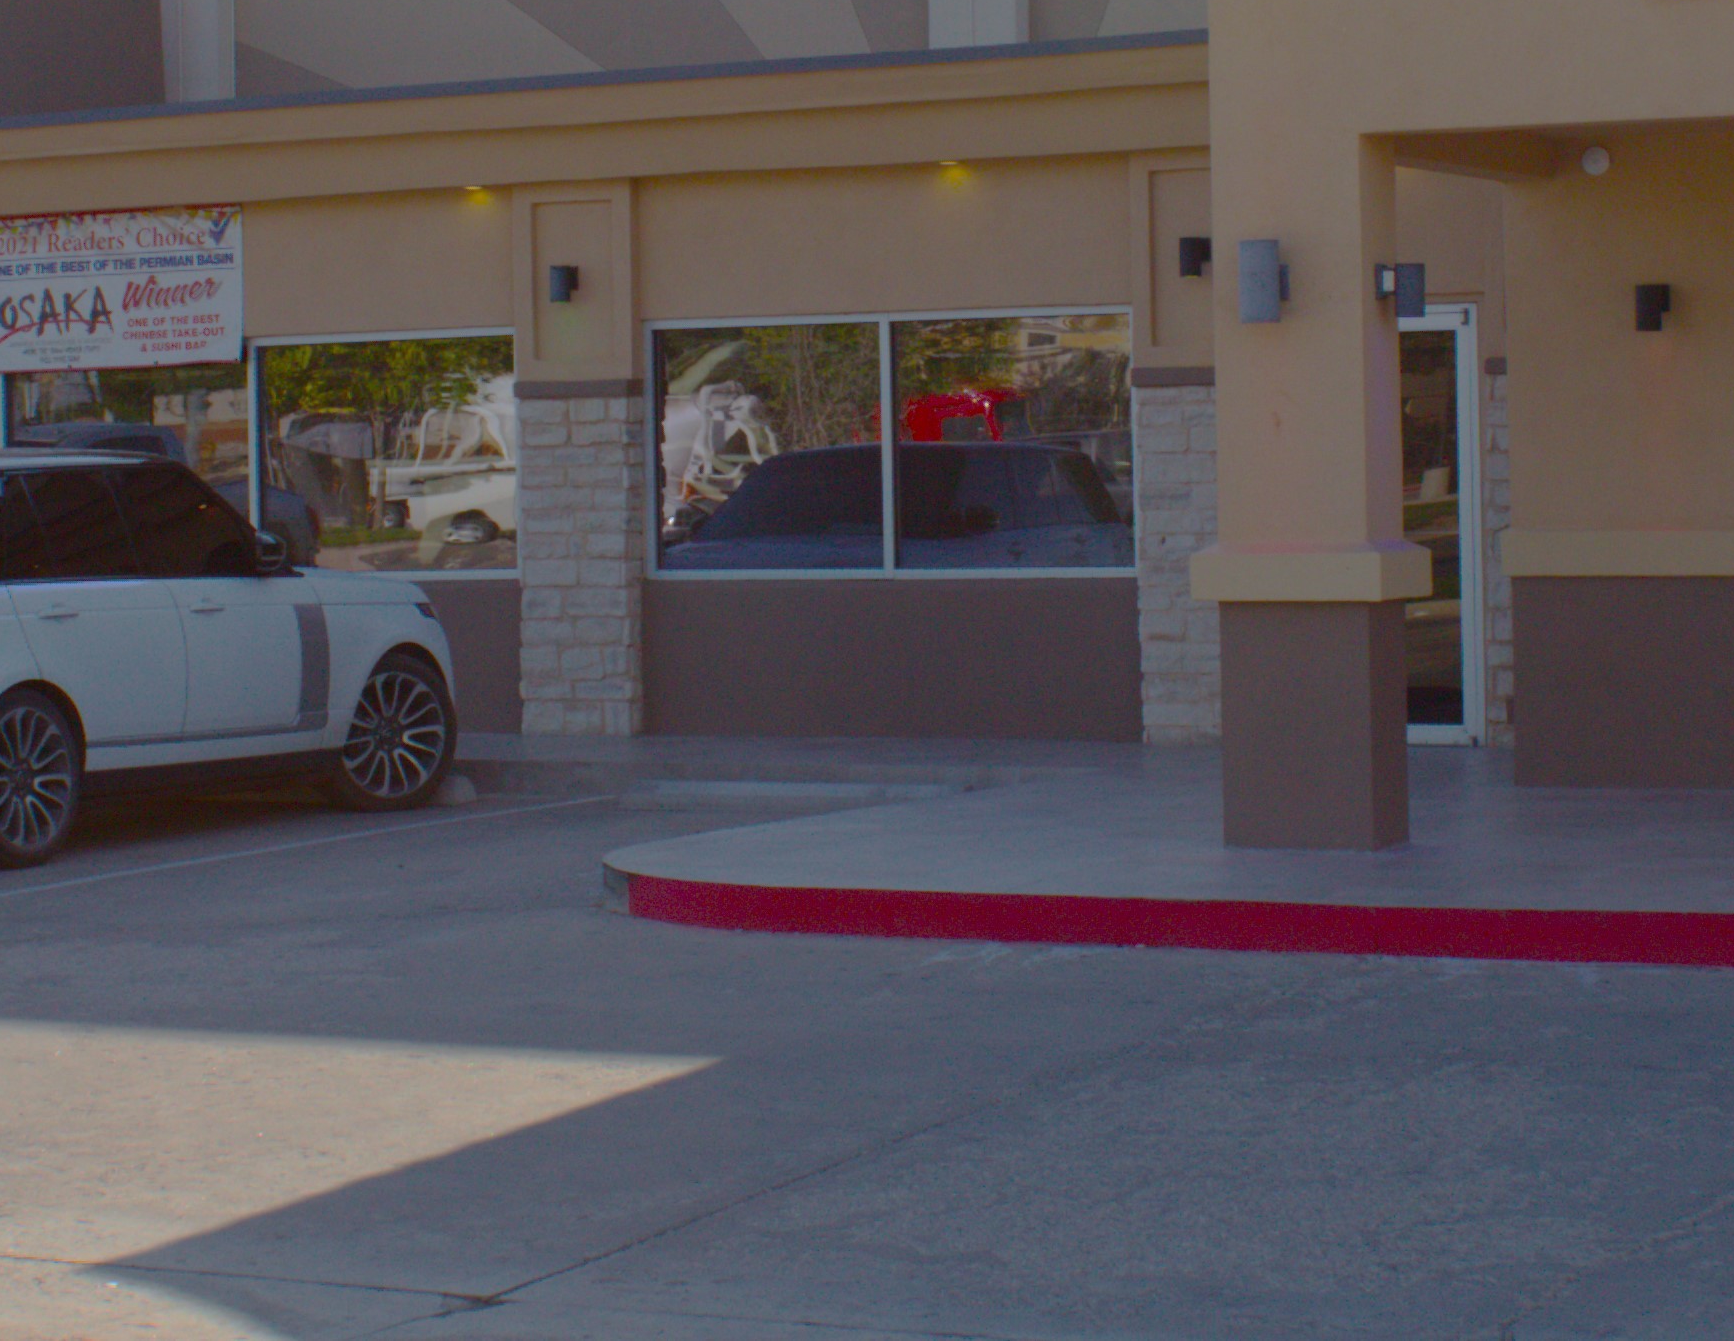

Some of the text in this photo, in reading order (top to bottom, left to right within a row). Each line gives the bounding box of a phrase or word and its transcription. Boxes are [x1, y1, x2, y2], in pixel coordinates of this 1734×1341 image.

[136, 226, 206, 249] Choice
[16, 264, 31, 276] OF
[34, 262, 57, 275] THE
[61, 260, 91, 273] BEST
[93, 259, 109, 271] OF
[113, 257, 137, 270] THE
[139, 254, 194, 269] PERMIAN
[196, 252, 234, 265] BASIN
[121, 274, 222, 312] Winner
[127, 314, 220, 327] ONE OF THE BEST
[122, 327, 226, 340] CHINESE TAKE-OUT
[151, 341, 182, 352] SUSHI
